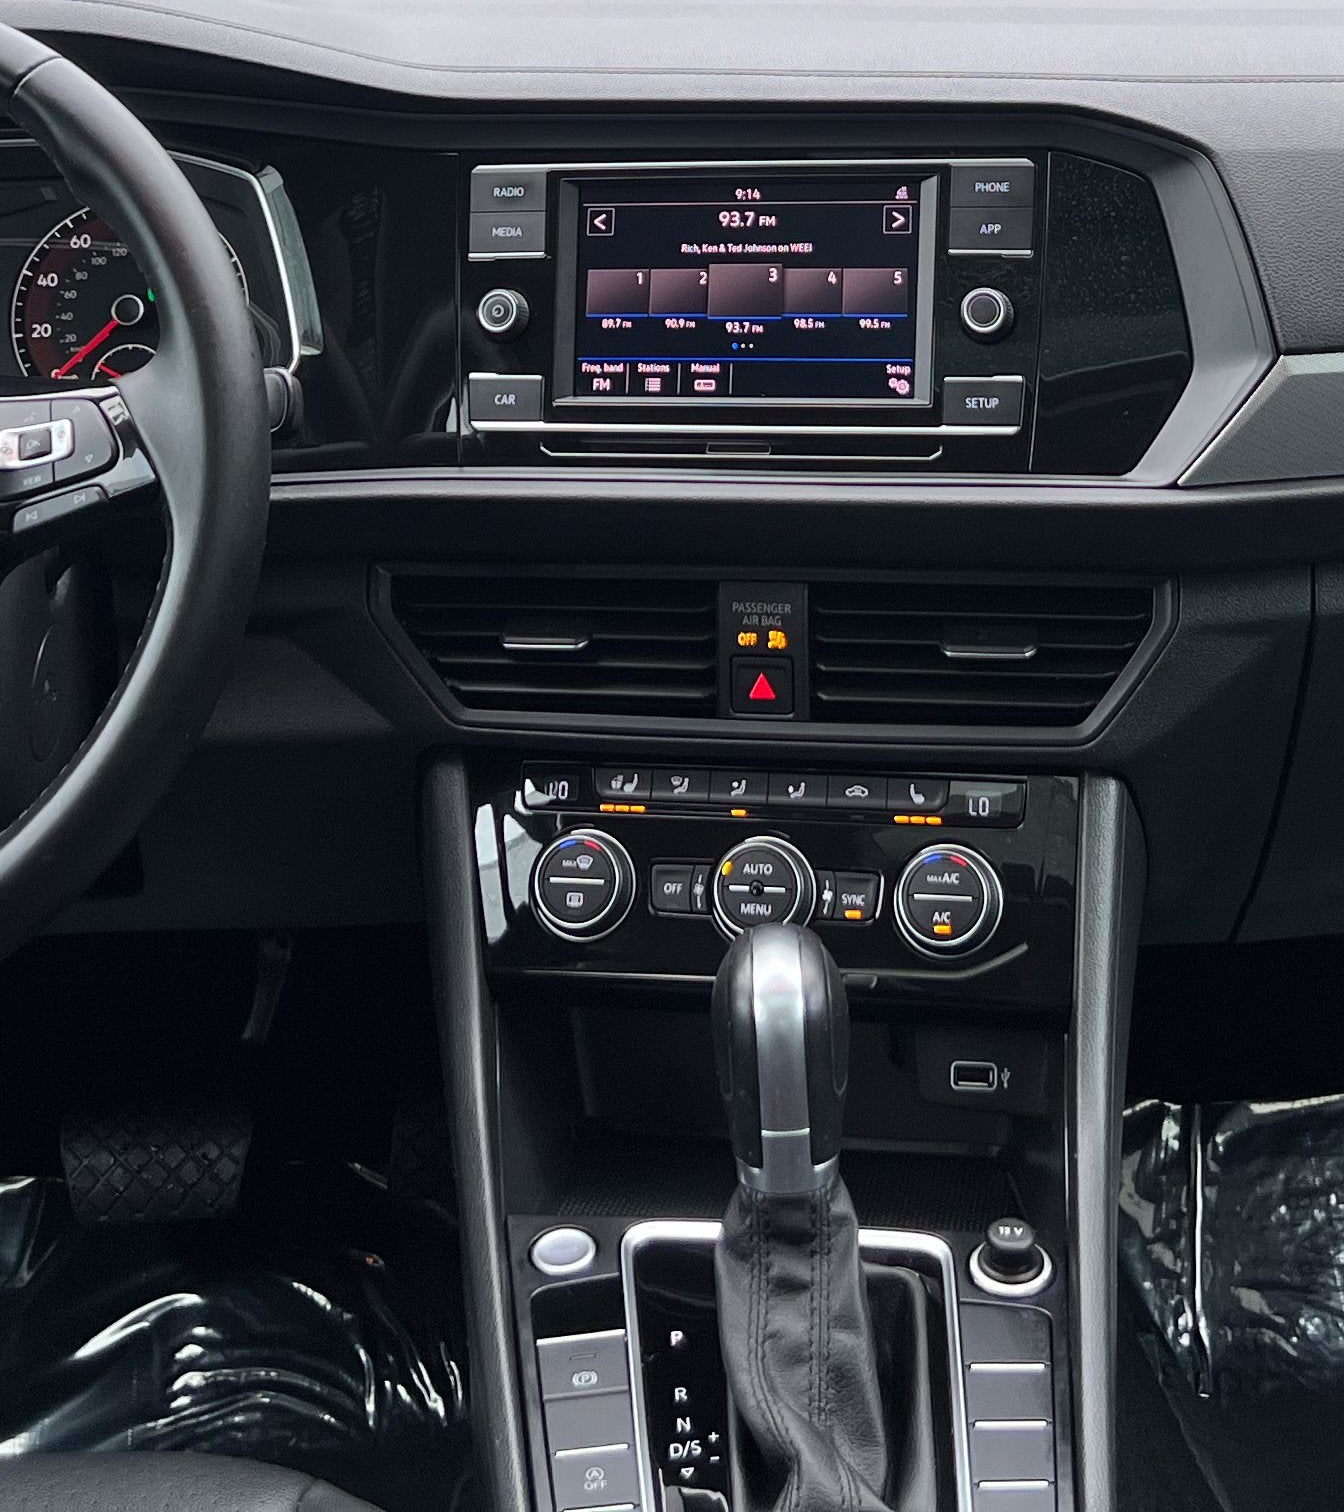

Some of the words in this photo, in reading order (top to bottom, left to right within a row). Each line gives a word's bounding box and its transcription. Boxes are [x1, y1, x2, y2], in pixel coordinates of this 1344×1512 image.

[493, 186, 525, 199] RADIO
[974, 181, 1010, 193] PHONE
[734, 188, 761, 201] 9:14
[718, 211, 755, 228] 93.7
[758, 215, 777, 227] FM
[492, 226, 523, 238] MEDIA
[980, 223, 1002, 235] APP
[69, 233, 92, 249] 60
[680, 243, 701, 255] Rich,
[702, 243, 719, 253] Ken
[728, 243, 743, 253] Ted
[743, 243, 777, 253] Johnson
[778, 244, 789, 253] on
[91, 256, 107, 266] 100
[36, 272, 59, 288] 40
[74, 271, 88, 281] 80
[636, 271, 643, 285] 1
[699, 271, 708, 285] 2
[768, 267, 778, 283] 3
[827, 270, 837, 285] 4
[893, 270, 903, 285] 5
[63, 290, 77, 300] 60
[60, 311, 74, 321] 40
[31, 323, 53, 338] 20
[725, 321, 750, 334] 93.7
[751, 324, 764, 334] FM
[814, 320, 825, 329] FM
[859, 318, 879, 329] 99.5
[880, 321, 891, 330] FM
[64, 333, 77, 343] 20
[603, 362, 624, 373] band
[637, 362, 671, 373] Stations
[690, 362, 720, 373] Manual
[886, 363, 911, 376] Setup
[592, 377, 611, 392] FM
[494, 394, 516, 406] CAR
[965, 397, 999, 410] SETUP
[732, 601, 792, 614] PASSENGER
[742, 615, 760, 626] AIR
[761, 615, 782, 627] BAG
[737, 631, 758, 647] OFF
[968, 796, 990, 817] LO
[742, 862, 774, 876] AUTO
[942, 872, 960, 884] A/C
[663, 882, 683, 895] OFF
[841, 892, 867, 907] SYNC
[740, 903, 773, 917] MENU
[932, 911, 952, 924] A/C
[1013, 1226, 1024, 1237] V
[669, 1330, 684, 1347] P
[674, 1386, 689, 1403] R
[676, 1416, 692, 1434] N
[669, 1440, 702, 1461] D/S
[583, 1480, 608, 1491] OFF
